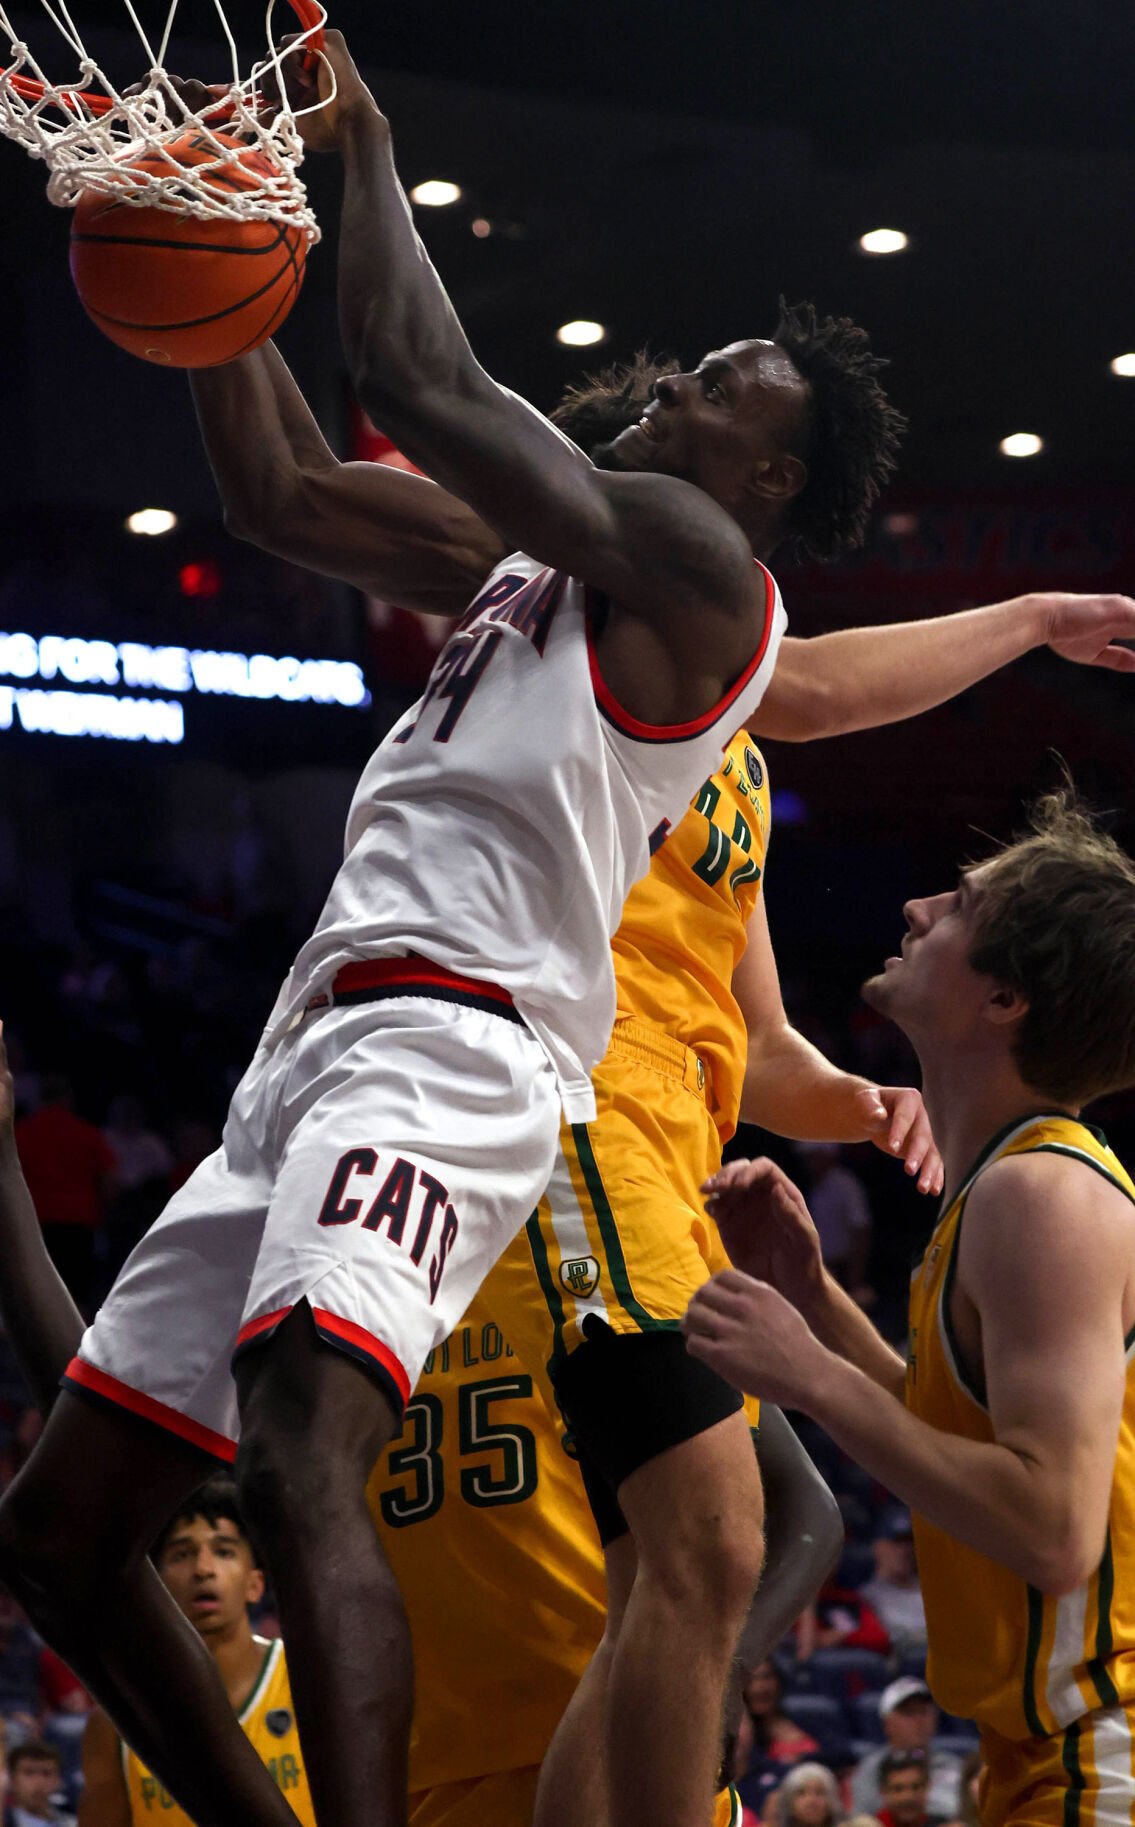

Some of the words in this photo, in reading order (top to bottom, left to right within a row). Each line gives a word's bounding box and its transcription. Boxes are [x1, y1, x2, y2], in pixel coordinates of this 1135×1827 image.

[38, 636, 121, 685] FOR
[318, 1147, 459, 1306] CATS
[380, 1374, 538, 1529] 35
